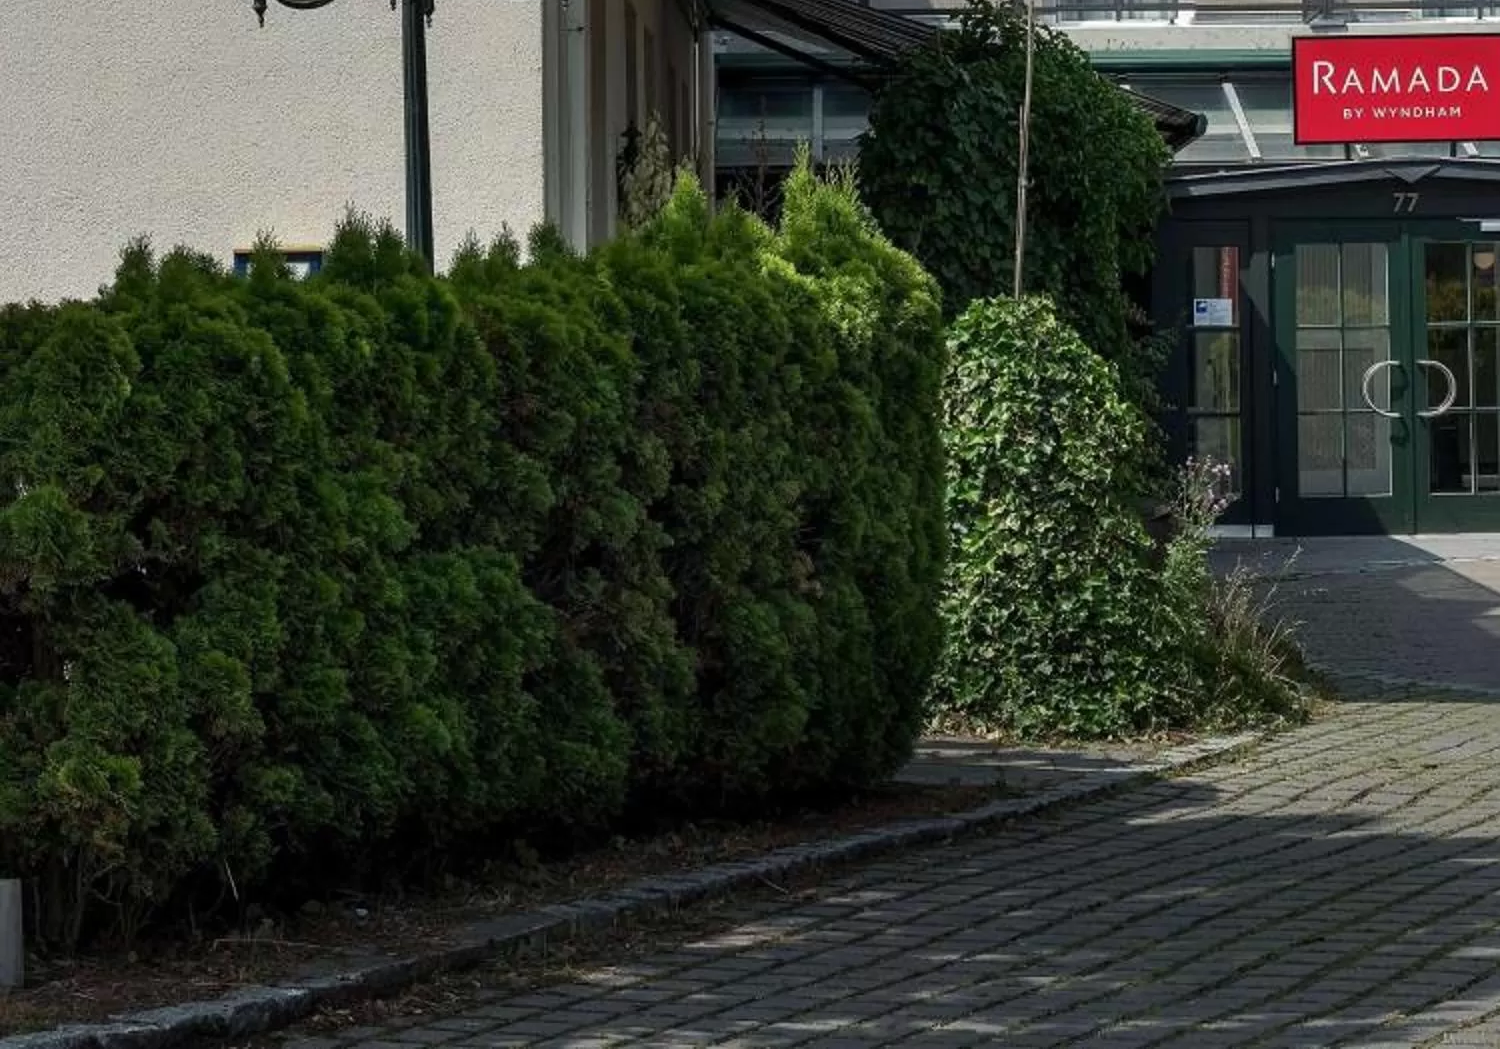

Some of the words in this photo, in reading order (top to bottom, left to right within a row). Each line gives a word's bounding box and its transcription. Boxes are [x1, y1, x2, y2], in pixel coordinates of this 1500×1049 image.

[1312, 60, 1489, 95] RAMADA
[1343, 108, 1364, 119] BY
[1372, 106, 1462, 119] WYNDHAM
[1393, 192, 1419, 212] 77
